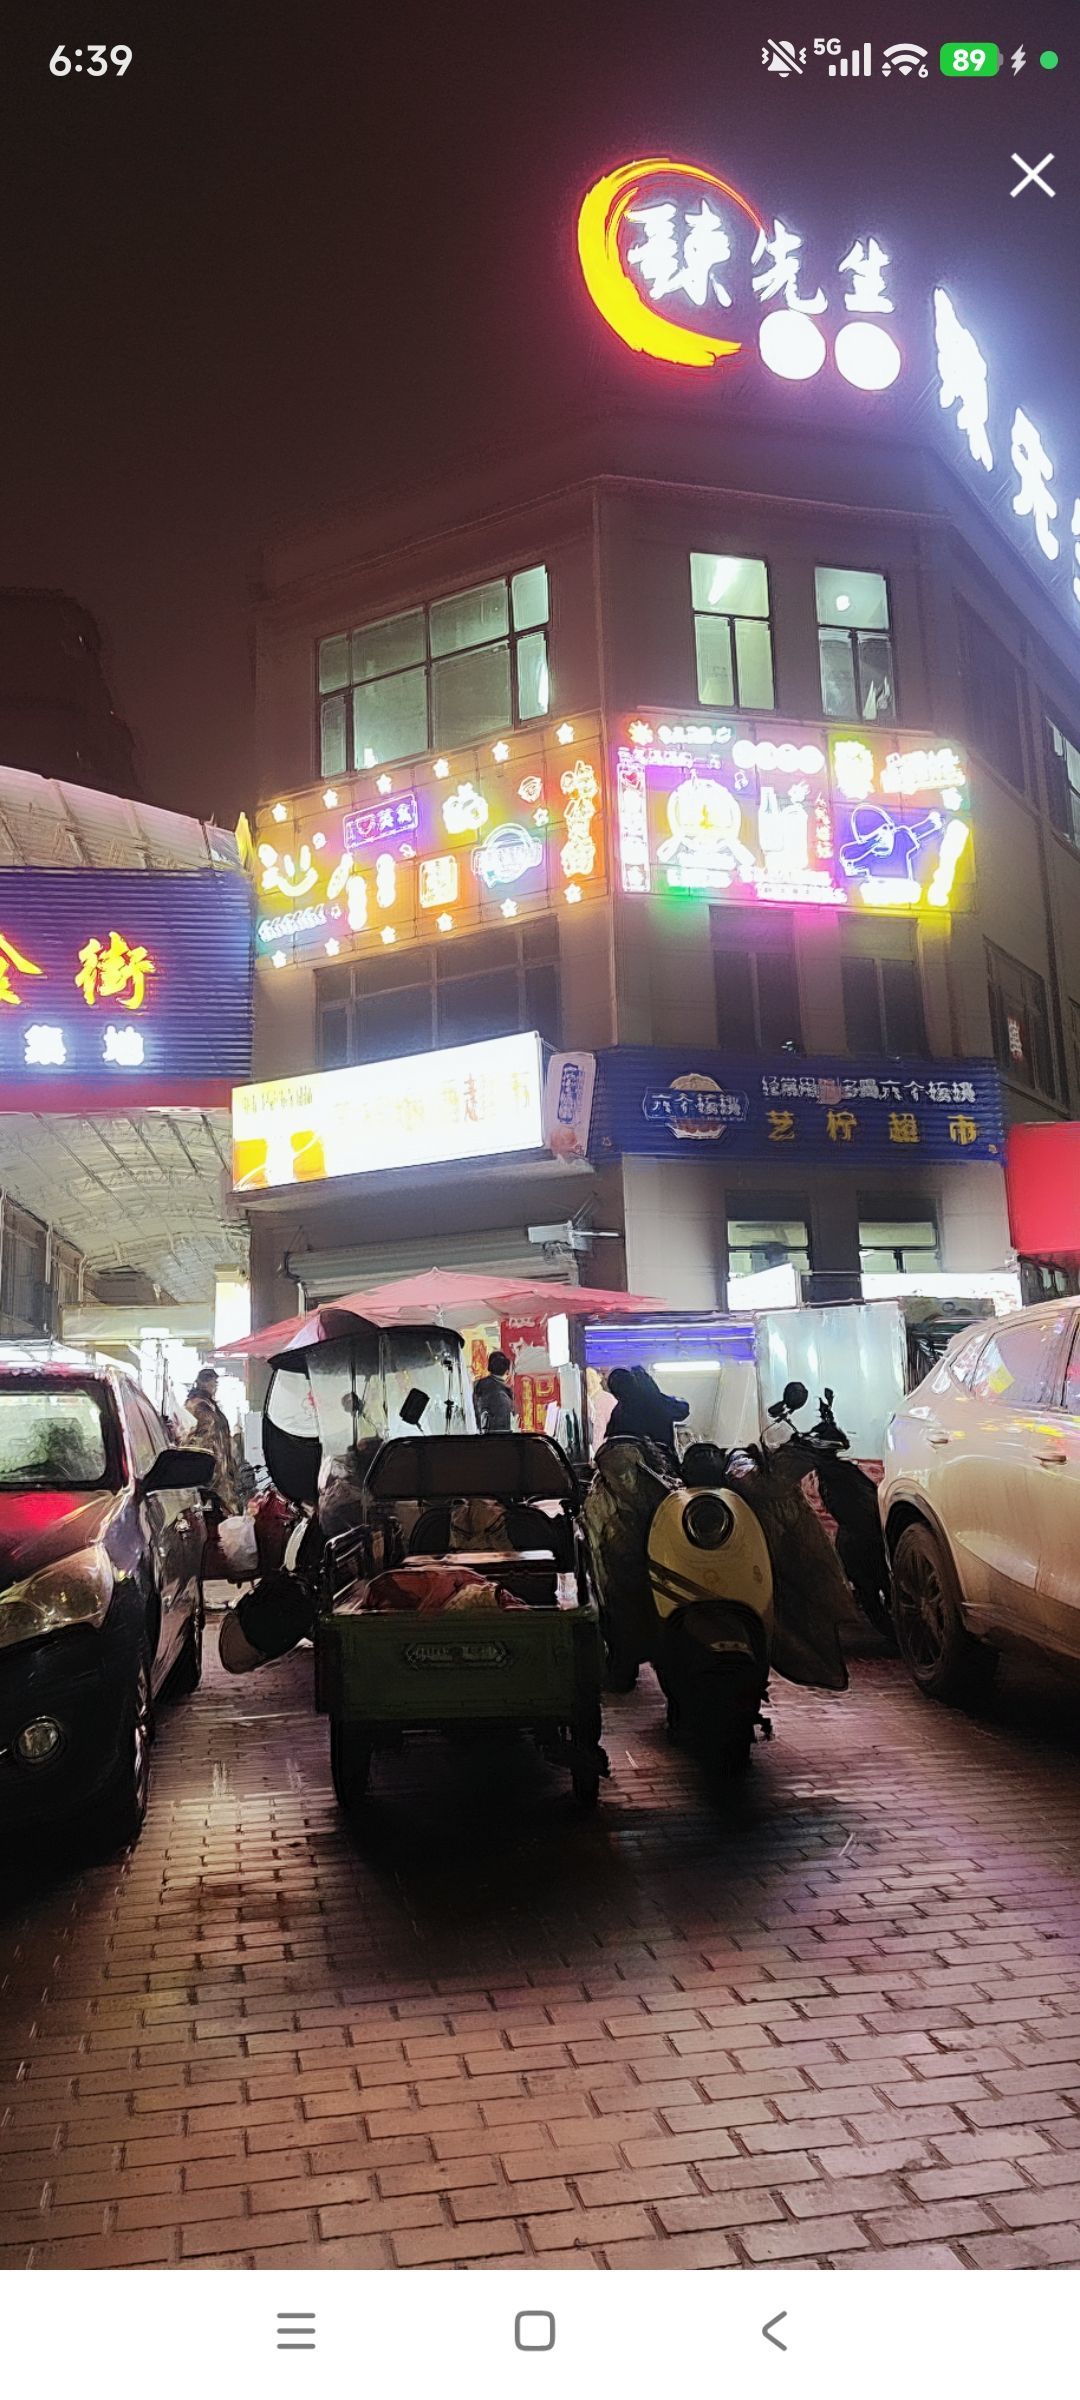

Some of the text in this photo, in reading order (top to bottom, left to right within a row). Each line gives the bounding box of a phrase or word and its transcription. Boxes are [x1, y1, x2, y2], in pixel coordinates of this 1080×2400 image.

[651, 1092, 742, 1116] 六个核桃
[766, 1109, 977, 1146] 艺柠超市
